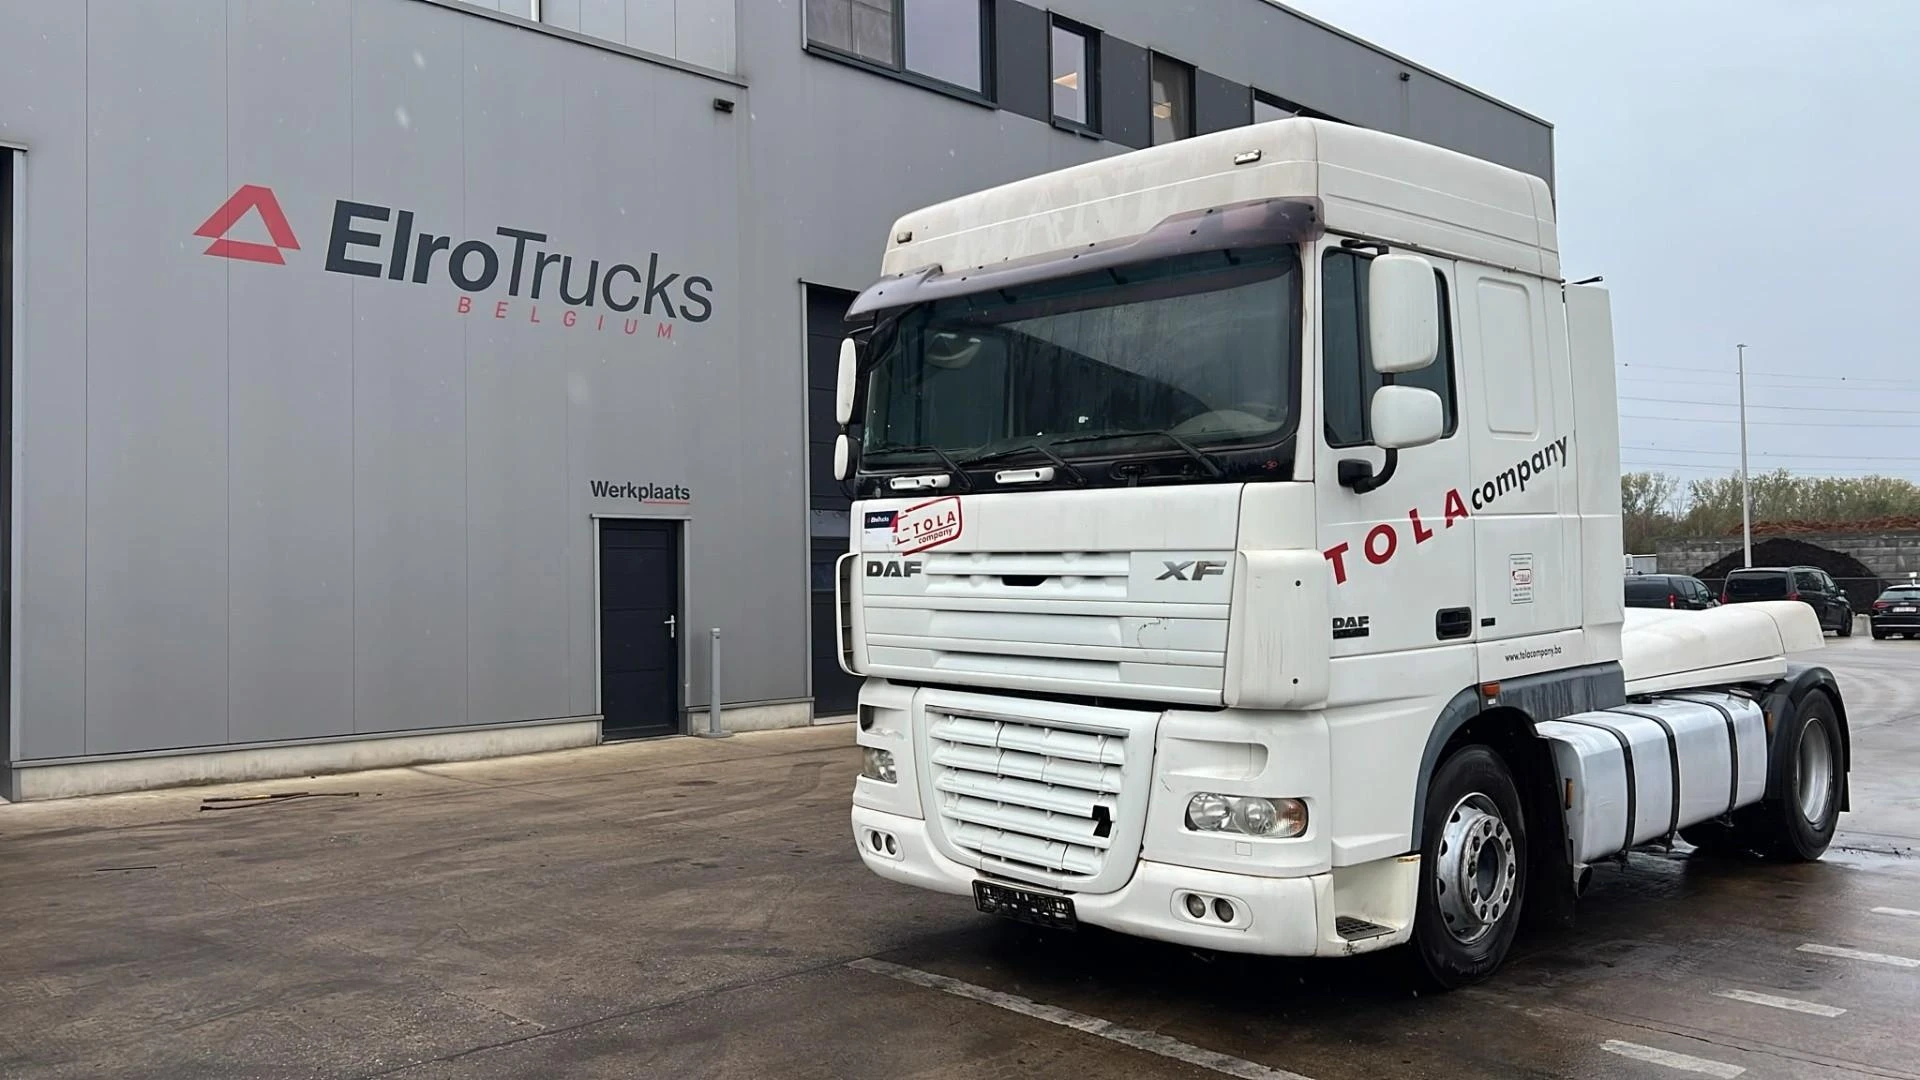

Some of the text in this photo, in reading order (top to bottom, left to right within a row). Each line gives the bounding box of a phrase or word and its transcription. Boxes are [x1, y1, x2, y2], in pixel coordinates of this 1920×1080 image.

[325, 200, 713, 323] ElroTrucks
[457, 296, 673, 339] BELGIUM
[590, 480, 690, 502] Werkplaats
[1323, 436, 1567, 585] TOLA company
[913, 511, 956, 535] TOLA
[918, 528, 953, 544] company
[866, 561, 922, 577] DAF
[1155, 560, 1227, 581] XF
[1332, 616, 1369, 628] DAF
